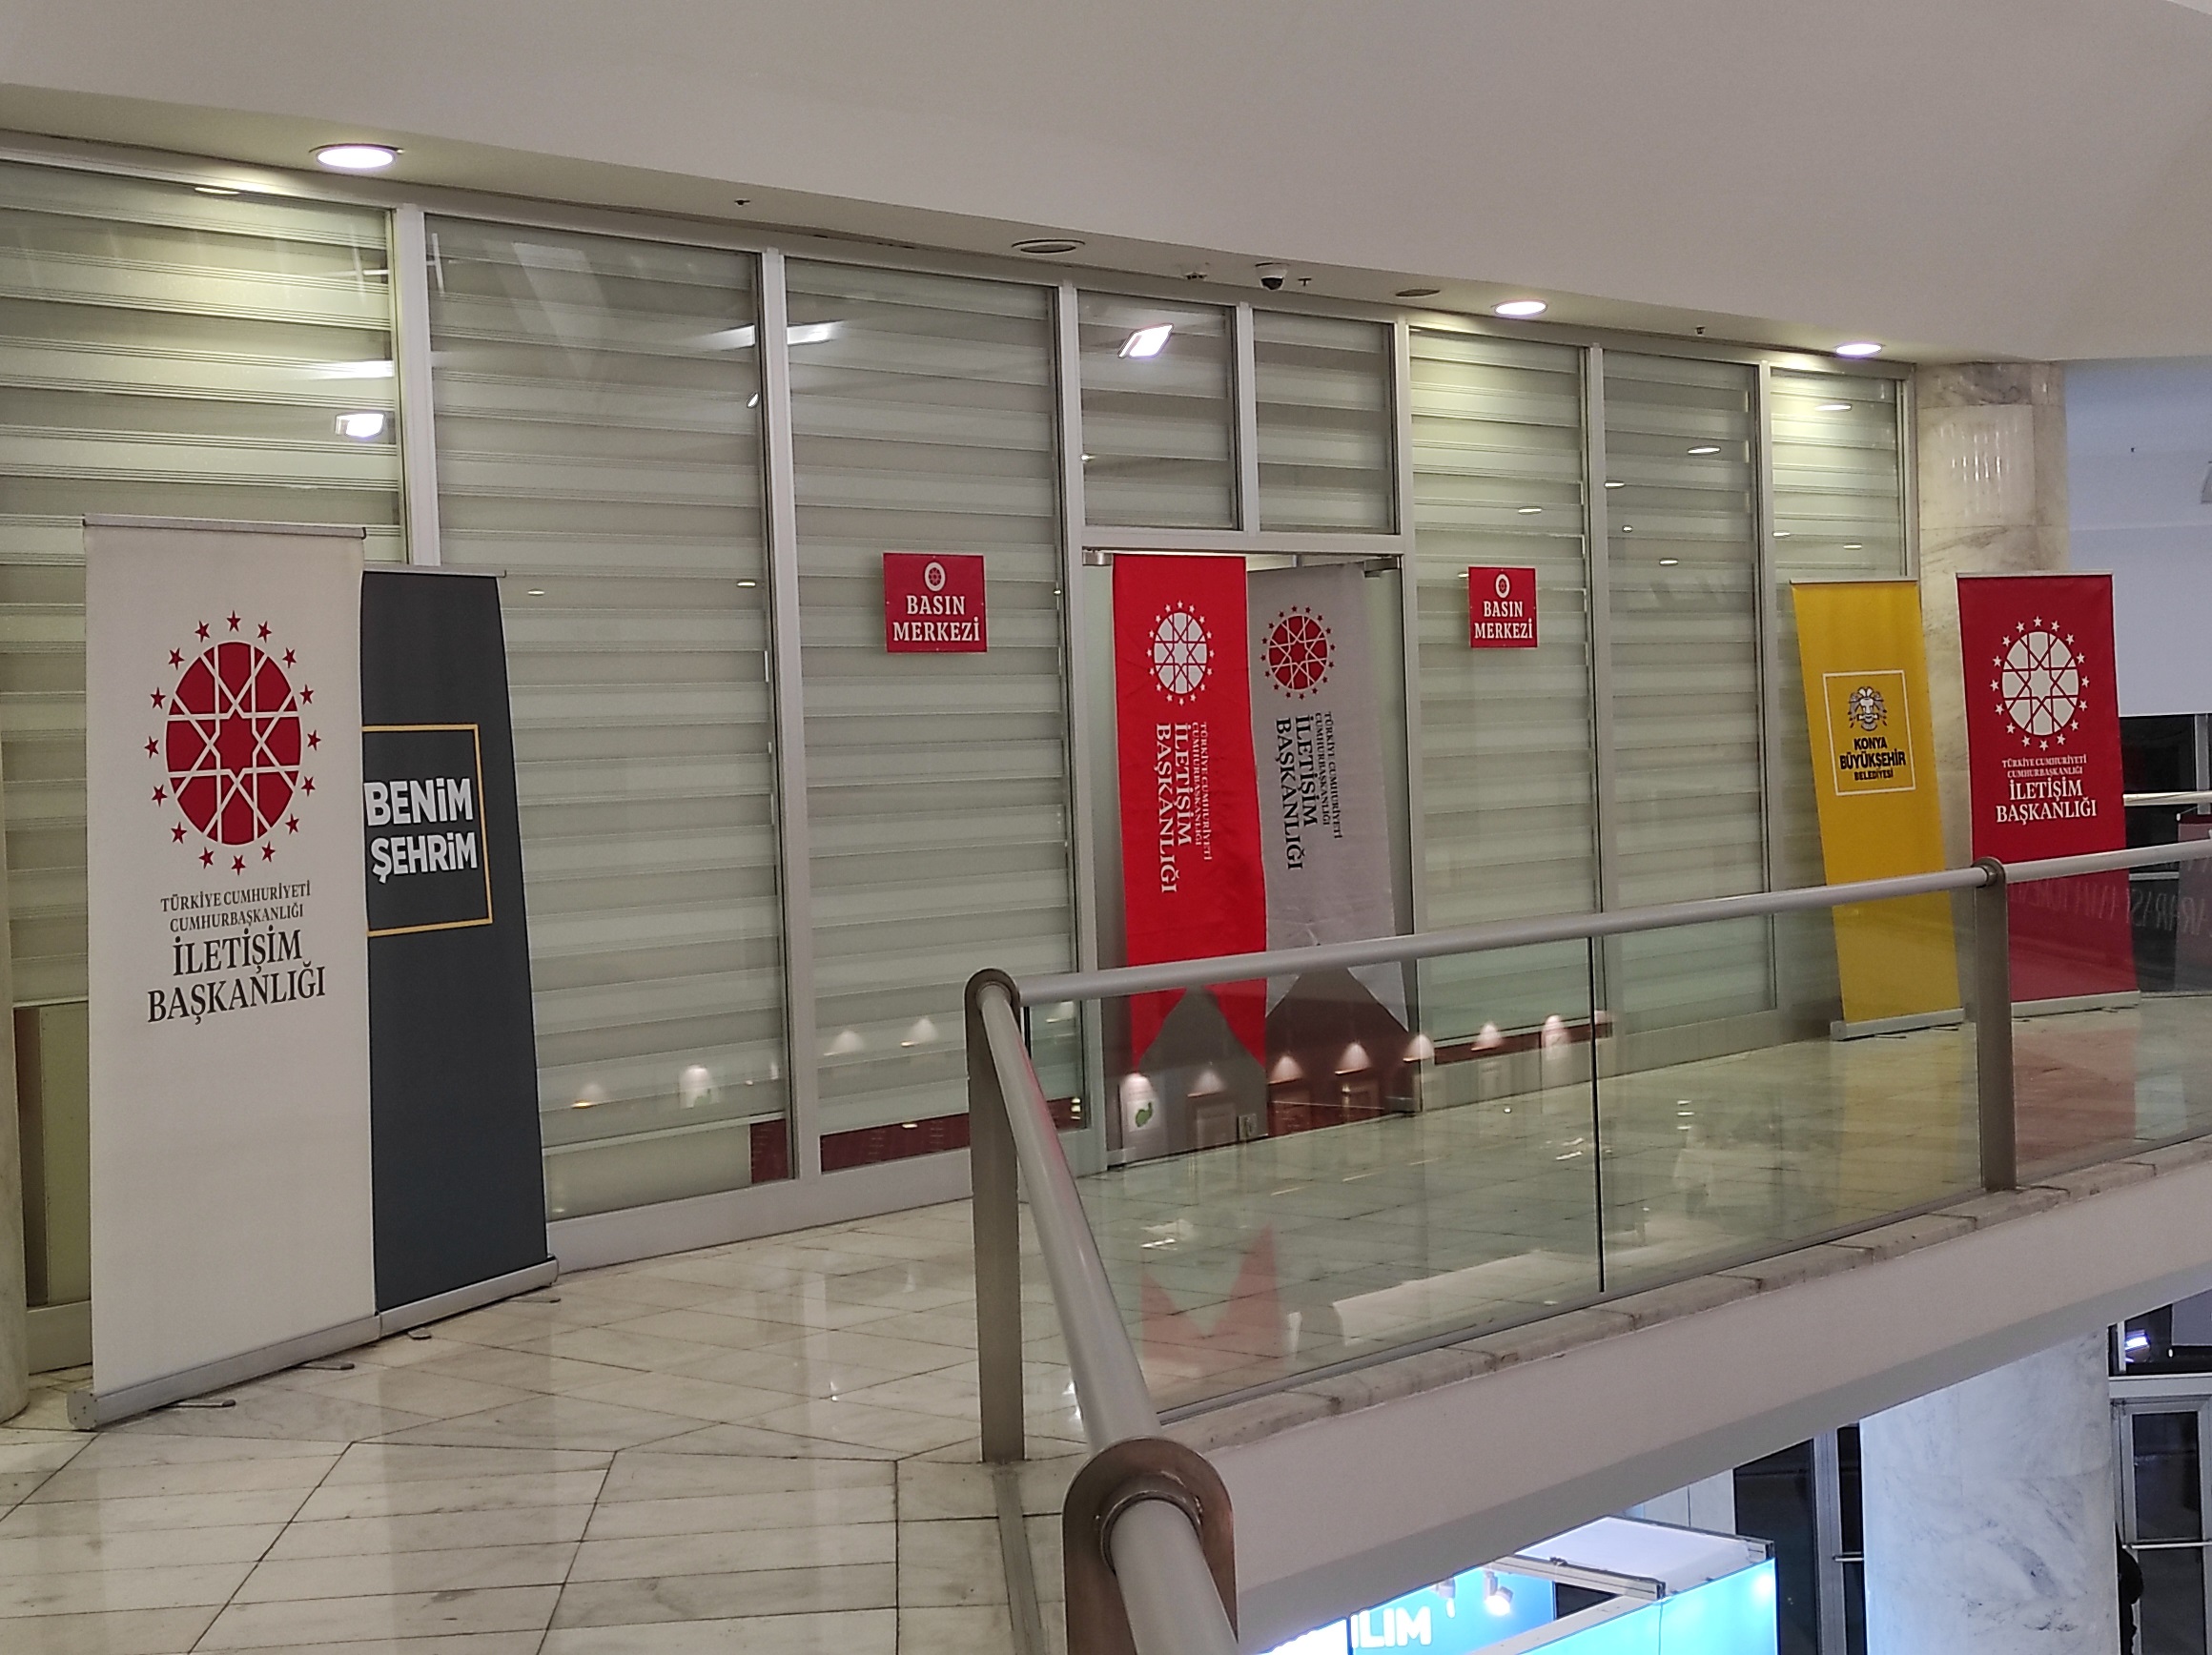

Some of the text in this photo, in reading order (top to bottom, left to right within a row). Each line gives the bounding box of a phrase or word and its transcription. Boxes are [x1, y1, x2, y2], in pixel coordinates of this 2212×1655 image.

[907, 595, 965, 615] BASIN
[1484, 601, 1523, 618] BASIN
[892, 616, 980, 642] MERKEZİ
[1474, 618, 1533, 639] MERKEZİ
[1854, 736, 1887, 750] KONYA
[1295, 715, 1321, 827] İLETİŞİM
[1839, 748, 1906, 769] BÜYÜKŞEHİR
[1174, 723, 1195, 846] İLETİŞİM
[1854, 768, 1894, 781] BELEDİYESİ
[2009, 776, 2083, 802] İLETİŞİM
[1275, 717, 1305, 869] BAŞKANLIĞI
[1154, 723, 1179, 893] BAŞKANLIĞI
[1996, 797, 2097, 826] BAŞKANLIĞI
[160, 879, 311, 912] TÜRKİYE CUMHURİYETİ
[170, 902, 303, 932] CUMHURBAŞKANLIĞI
[173, 924, 302, 976] İLETİŞİM
[147, 960, 326, 1025] BAŞKANLIĞI
